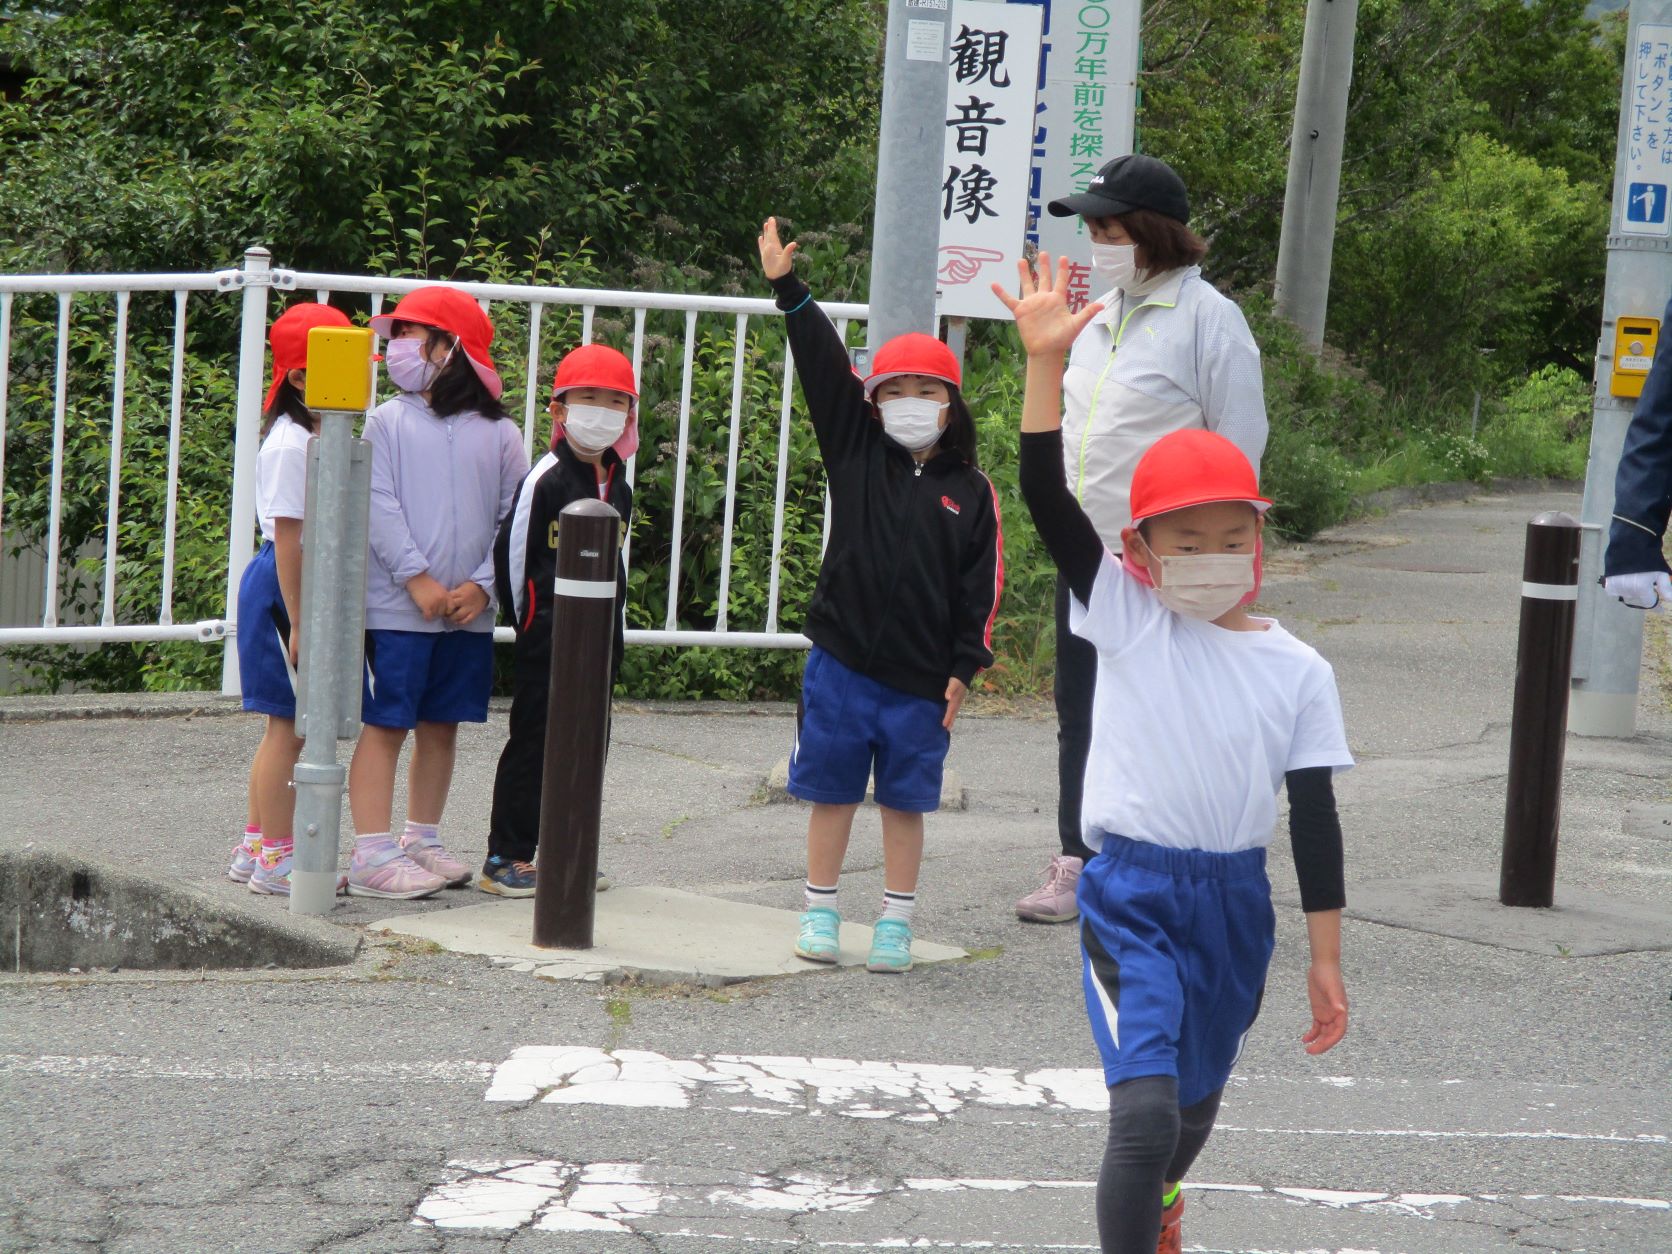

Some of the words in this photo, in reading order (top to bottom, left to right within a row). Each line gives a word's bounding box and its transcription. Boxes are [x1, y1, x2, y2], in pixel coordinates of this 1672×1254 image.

[942, 24, 1011, 224] 観音像
[1630, 41, 1652, 171] 押して下さい。
